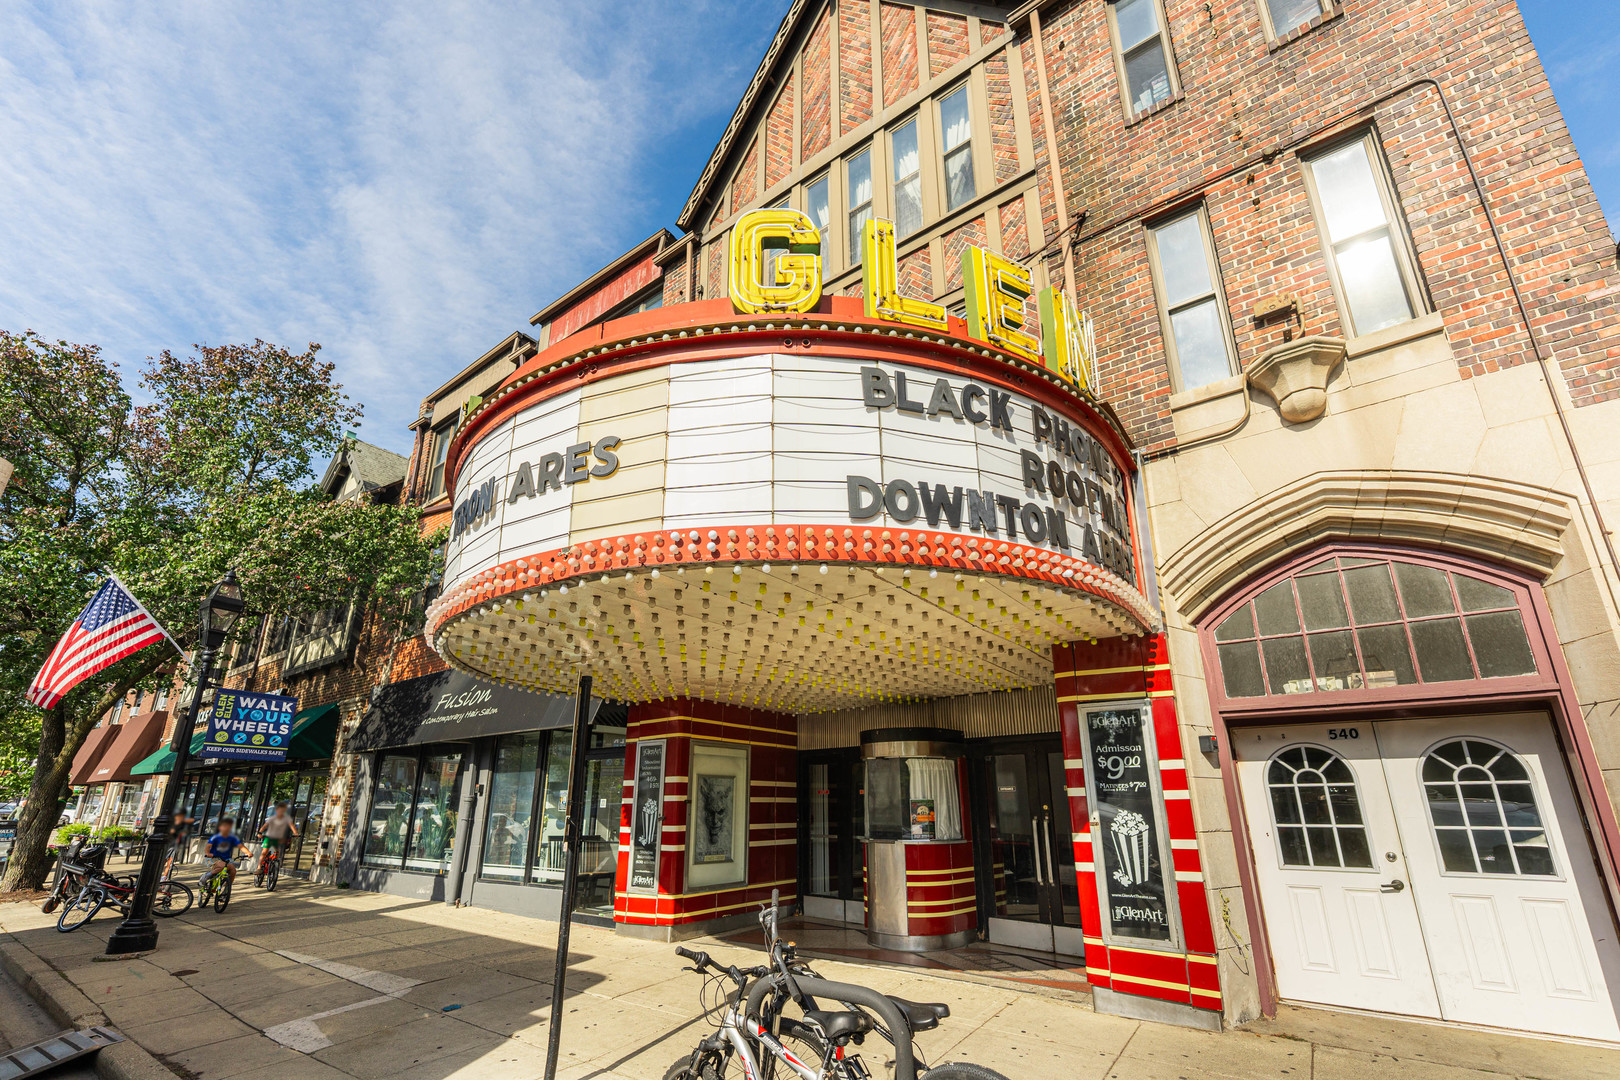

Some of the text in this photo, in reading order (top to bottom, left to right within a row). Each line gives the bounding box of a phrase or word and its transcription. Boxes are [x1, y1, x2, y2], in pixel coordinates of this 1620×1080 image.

[729, 208, 1101, 401] GLEN
[861, 366, 1014, 432] BLACK
[1032, 404, 1112, 486] PHONE
[453, 436, 621, 542] TRON ARES
[847, 475, 1070, 549] DOWNTON
[215, 694, 228, 718] GLEN
[223, 695, 236, 719] ELLYN
[239, 696, 294, 713] WALK
[434, 684, 492, 713] Fusion
[237, 708, 292, 724] YOUR
[464, 708, 480, 719] Hair
[478, 706, 498, 717] Salon
[214, 718, 290, 735] WHEELS
[1328, 727, 1359, 740] 540
[1096, 744, 1142, 753] Admisson
[1120, 905, 1163, 920] GlenArt
